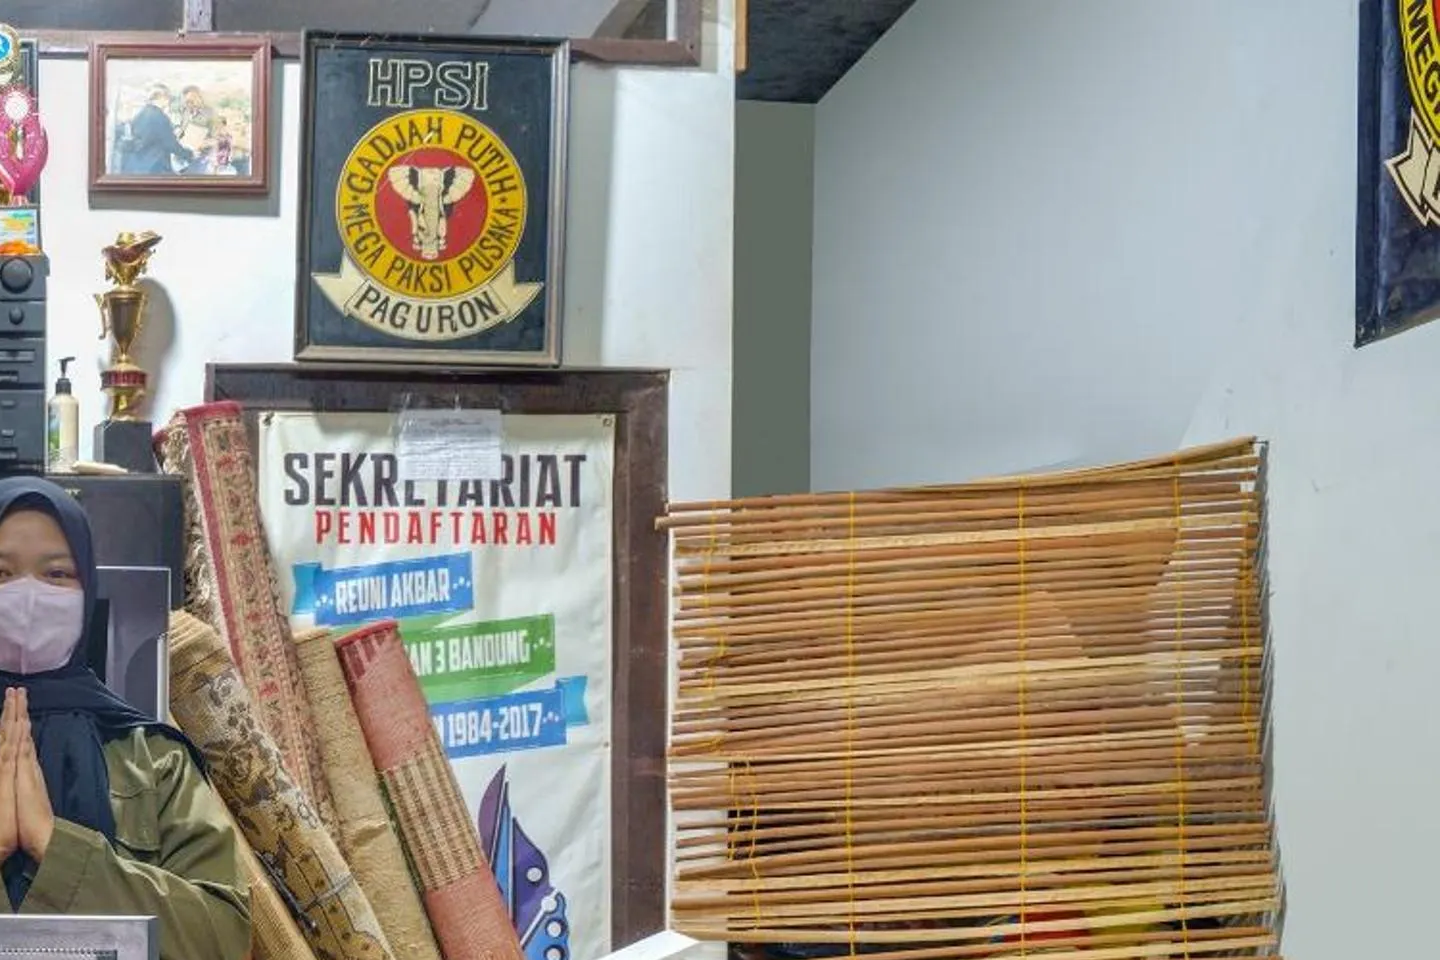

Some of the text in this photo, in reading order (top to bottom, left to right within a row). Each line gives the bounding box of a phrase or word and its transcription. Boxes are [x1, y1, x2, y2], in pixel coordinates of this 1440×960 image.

[1407, 0, 1440, 115] MEG
[367, 58, 490, 110] HPSI
[345, 117, 519, 195] GADJAH PUTIH
[343, 204, 520, 293] MEGA PAKSI PUSAKA
[353, 285, 501, 333] PAGURON
[315, 510, 557, 546] PENDAFTARAN
[335, 568, 451, 615] REUNI AKBAR
[435, 640, 445, 674] 3
[448, 629, 532, 673] BANDUNG
[448, 702, 544, 748] 1984-2017
